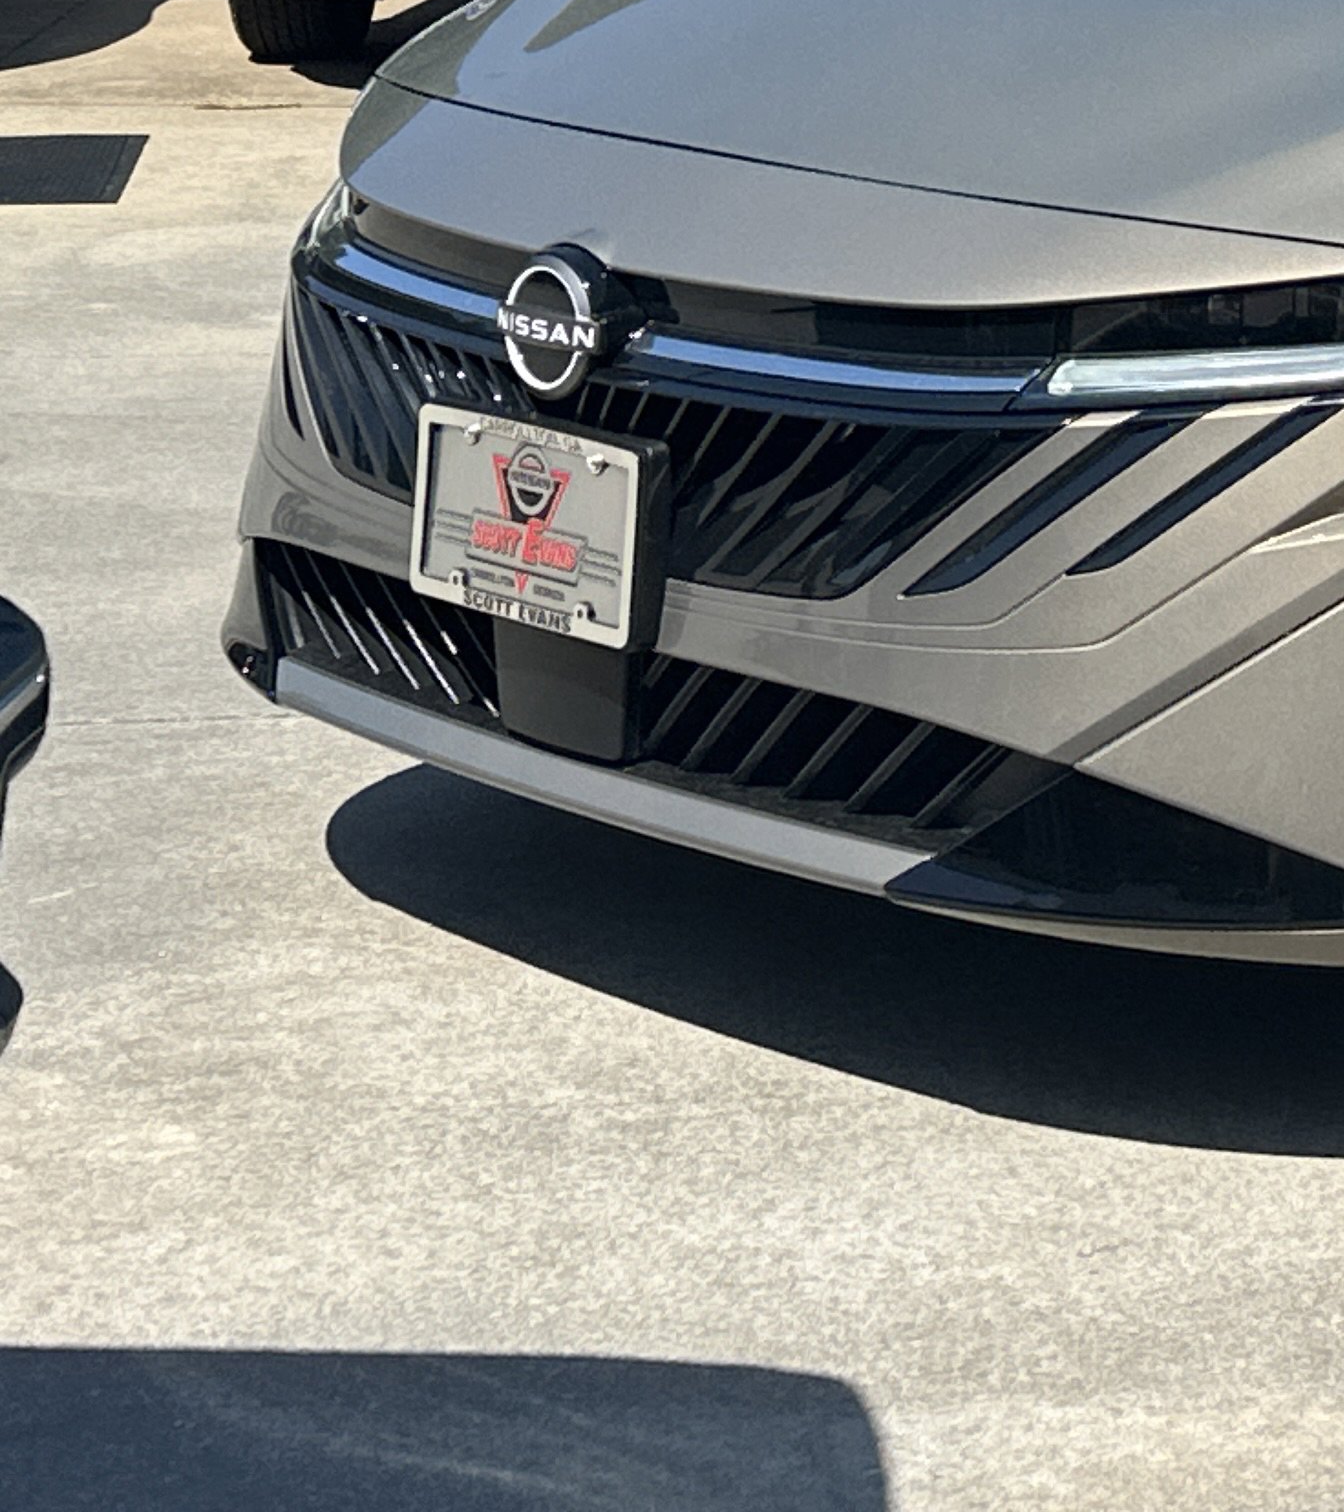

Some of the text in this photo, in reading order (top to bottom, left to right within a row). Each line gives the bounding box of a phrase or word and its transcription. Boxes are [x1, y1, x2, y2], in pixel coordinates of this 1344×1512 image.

[496, 306, 596, 349] NISSAN
[462, 589, 514, 617] SCOTT
[518, 601, 573, 634] EVANS
